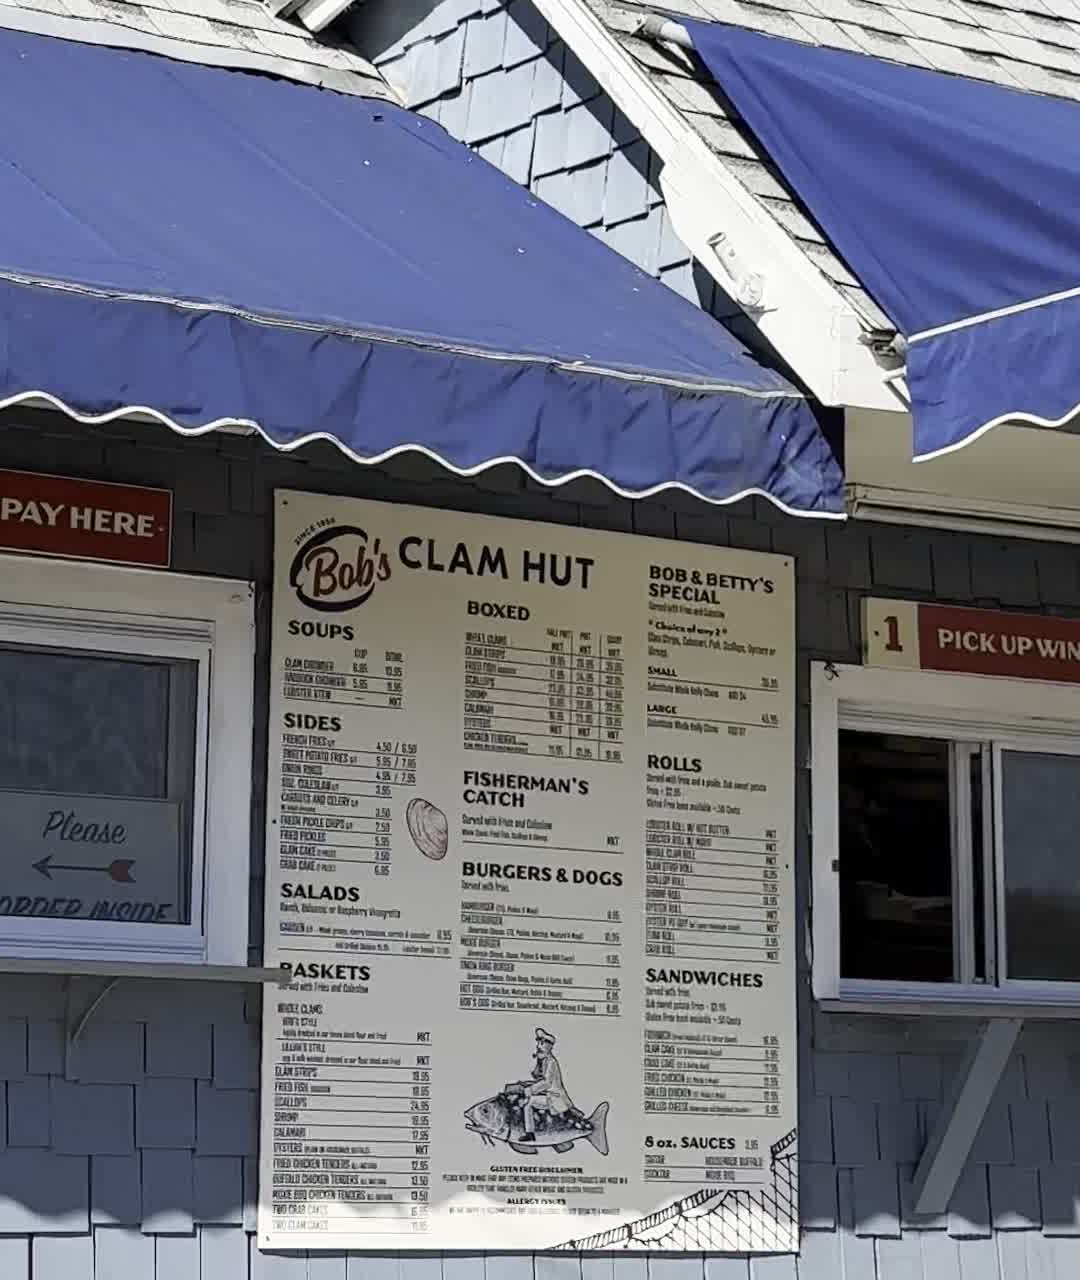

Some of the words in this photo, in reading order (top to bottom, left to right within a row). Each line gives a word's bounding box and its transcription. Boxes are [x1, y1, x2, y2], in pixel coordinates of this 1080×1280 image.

[1, 497, 66, 527] PAY
[70, 506, 155, 537] HERE
[304, 538, 392, 597] Bob's
[399, 536, 509, 579] CLAM
[523, 550, 594, 589] HUT
[649, 565, 687, 582] BOB
[691, 570, 702, 585] &
[707, 573, 774, 593] BETTY'S
[649, 583, 720, 604] SPECIAL
[468, 601, 530, 621] BOXED
[288, 620, 354, 640] SOUPS
[884, 616, 903, 652] 1
[938, 628, 997, 654] PICK
[1001, 635, 1033, 656] UP
[648, 666, 678, 677] SMALL
[647, 704, 677, 714] LARGE
[284, 712, 341, 731] SIDES
[648, 754, 702, 772] ROLLS
[464, 770, 589, 795] FISHERMAN'S
[463, 789, 525, 807] CATCH
[42, 808, 127, 844] Please
[463, 862, 552, 882] BURGERS
[556, 868, 568, 883] &
[573, 869, 623, 886] DOGS
[281, 883, 360, 902] SALADS
[646, 968, 763, 988] SANDWICHES
[657, 1138, 677, 1148] oz.
[681, 1136, 735, 1149] SAUCES
